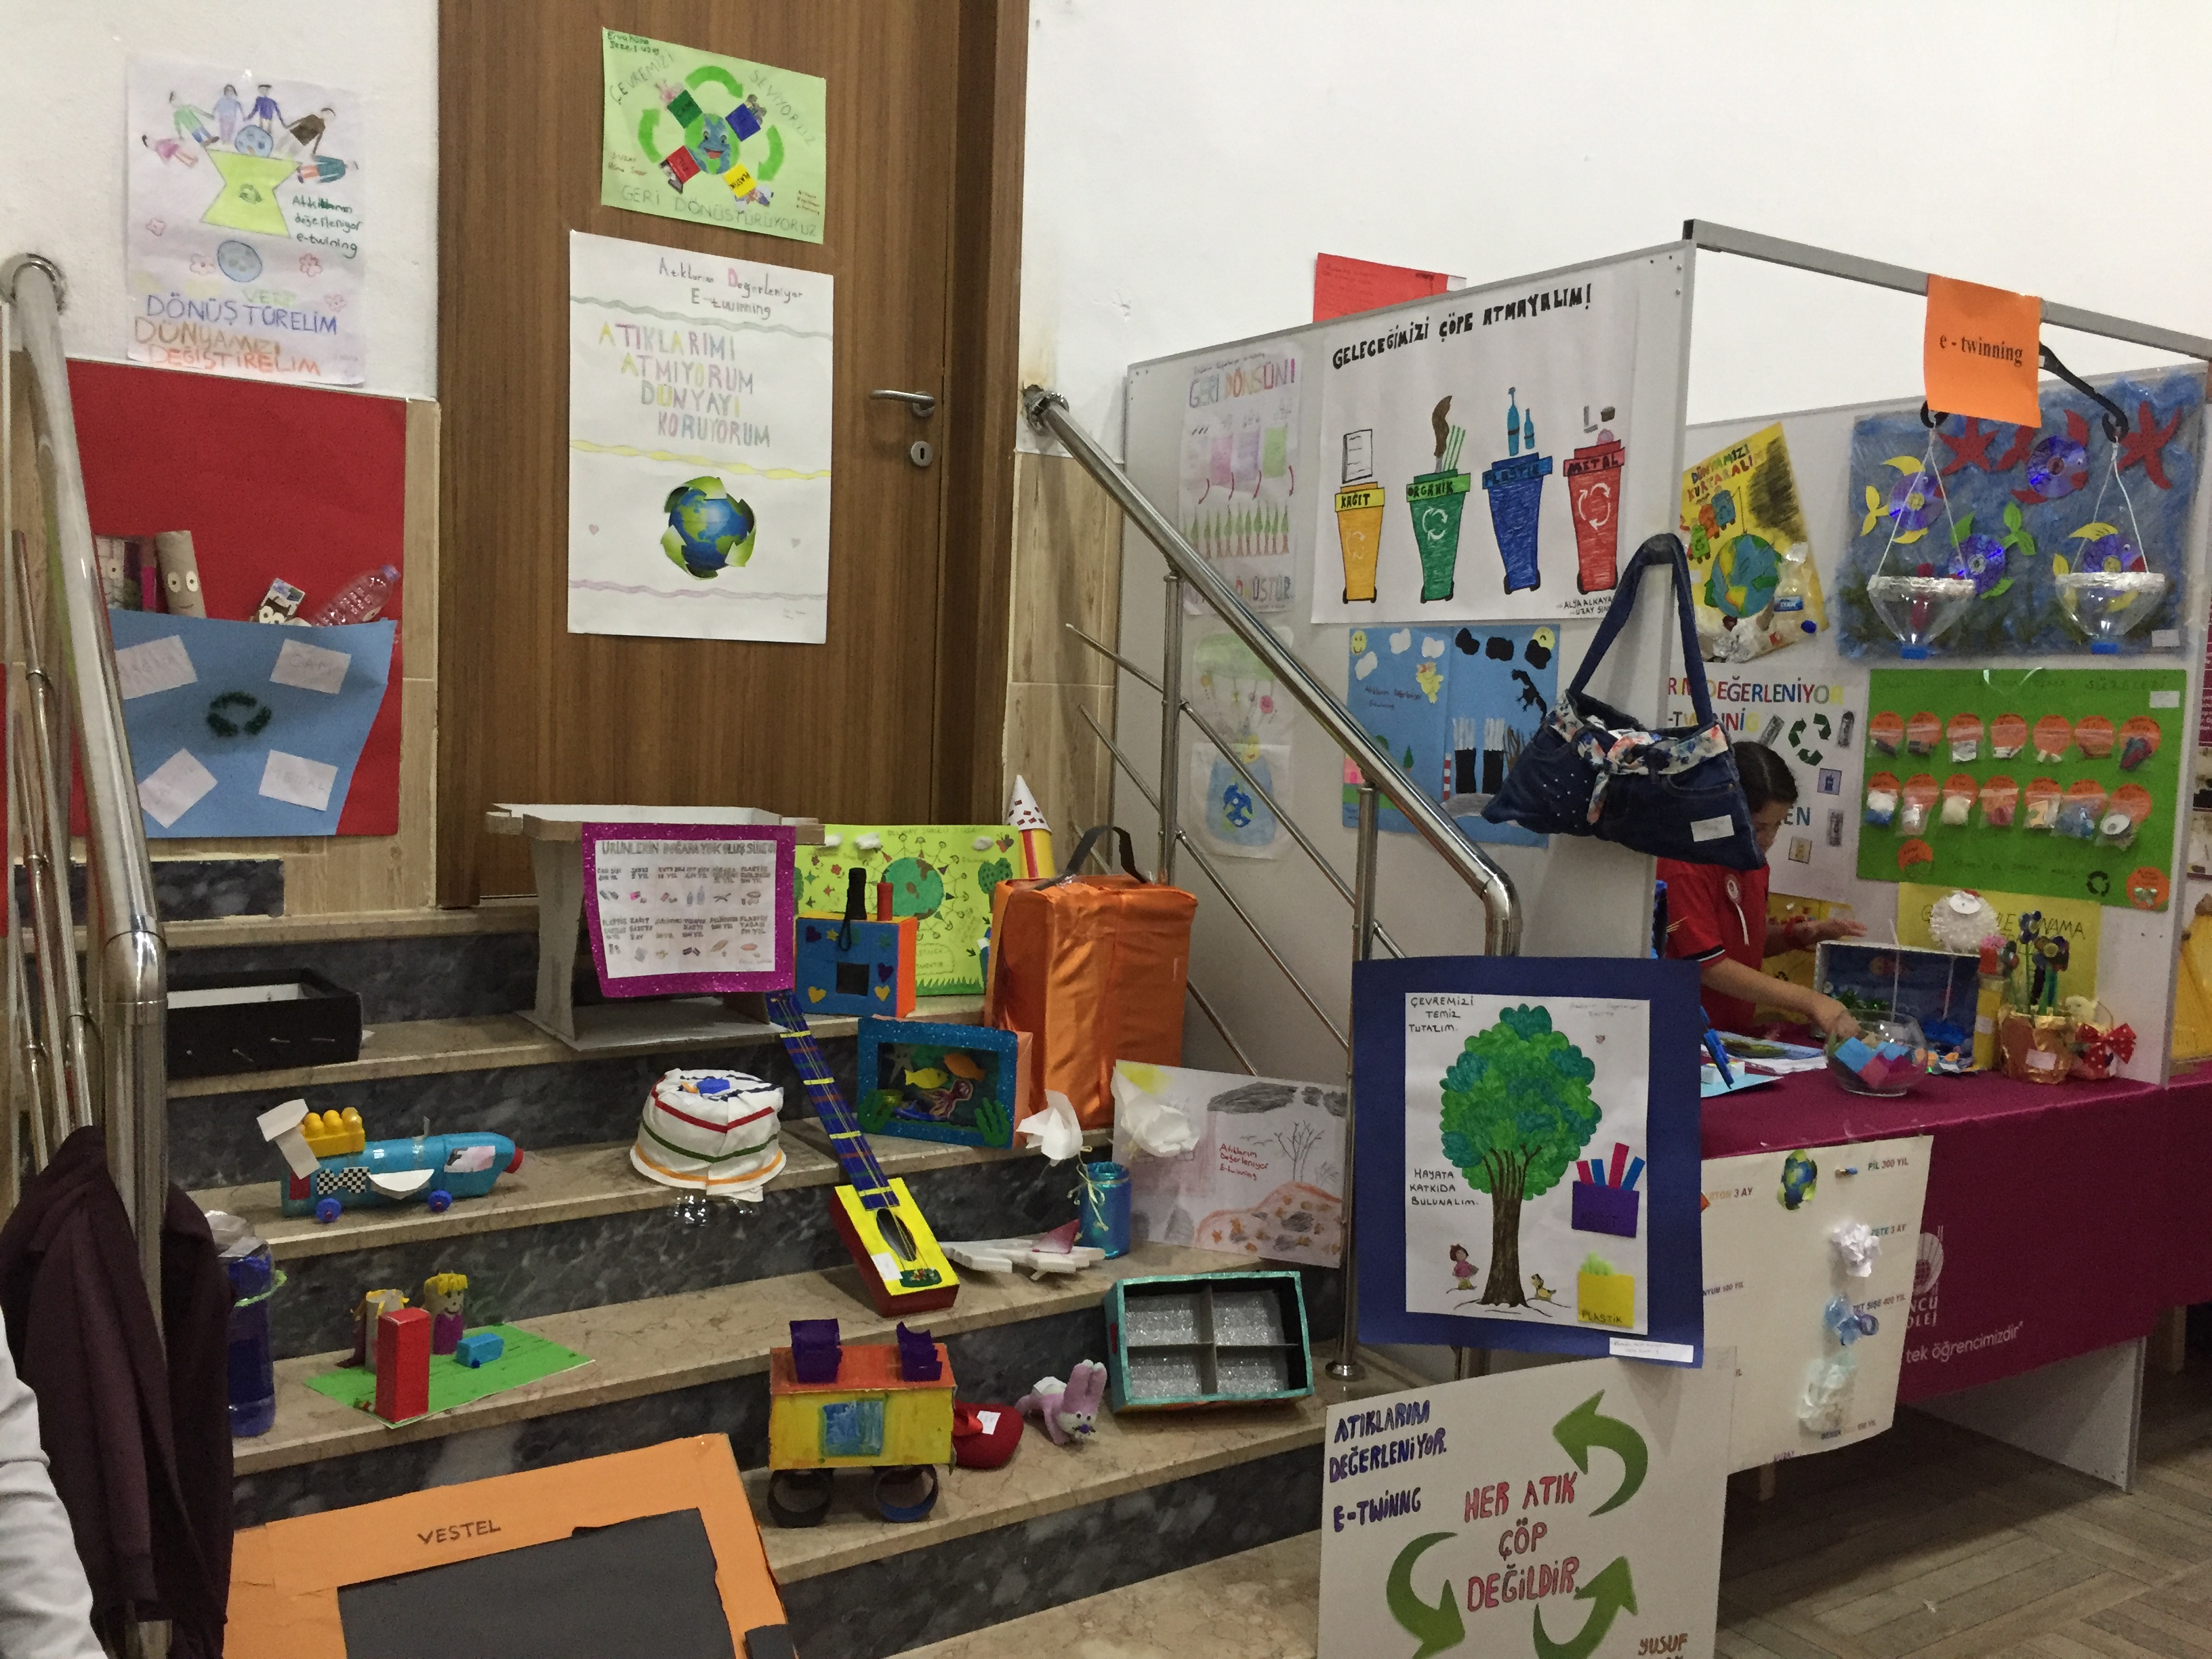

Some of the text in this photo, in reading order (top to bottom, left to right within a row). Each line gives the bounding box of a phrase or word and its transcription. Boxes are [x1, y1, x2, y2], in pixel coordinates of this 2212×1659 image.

[1332, 283, 1592, 370] GELECEĞİMİZİ ÇÖPE ATMAYALIM!
[598, 321, 736, 361] ATIKLARIMI
[1961, 335, 2023, 368] twinning
[620, 352, 754, 394] ATMIYORUM
[657, 411, 771, 448] KORUYORUM
[1567, 455, 1619, 475] METAL
[1410, 996, 1473, 1008] ÇEVREMİZİ
[1425, 1008, 1461, 1019] TEMİZ
[1414, 1168, 1454, 1180] HAYATA
[1410, 1183, 1456, 1193] KATKIDA
[1411, 1195, 1479, 1206] BULUNALIM.
[1734, 1188, 1740, 1198] 3
[1740, 1187, 1753, 1197] AY
[1906, 1345, 1928, 1364] tek
[1334, 1399, 1431, 1443] ATIKLARIM
[1464, 1471, 1577, 1523] HER ATIK
[417, 1519, 501, 1546] VESTEL
[1498, 1517, 1548, 1561] ÇÖP
[1637, 1633, 1688, 1656] YUSUF
